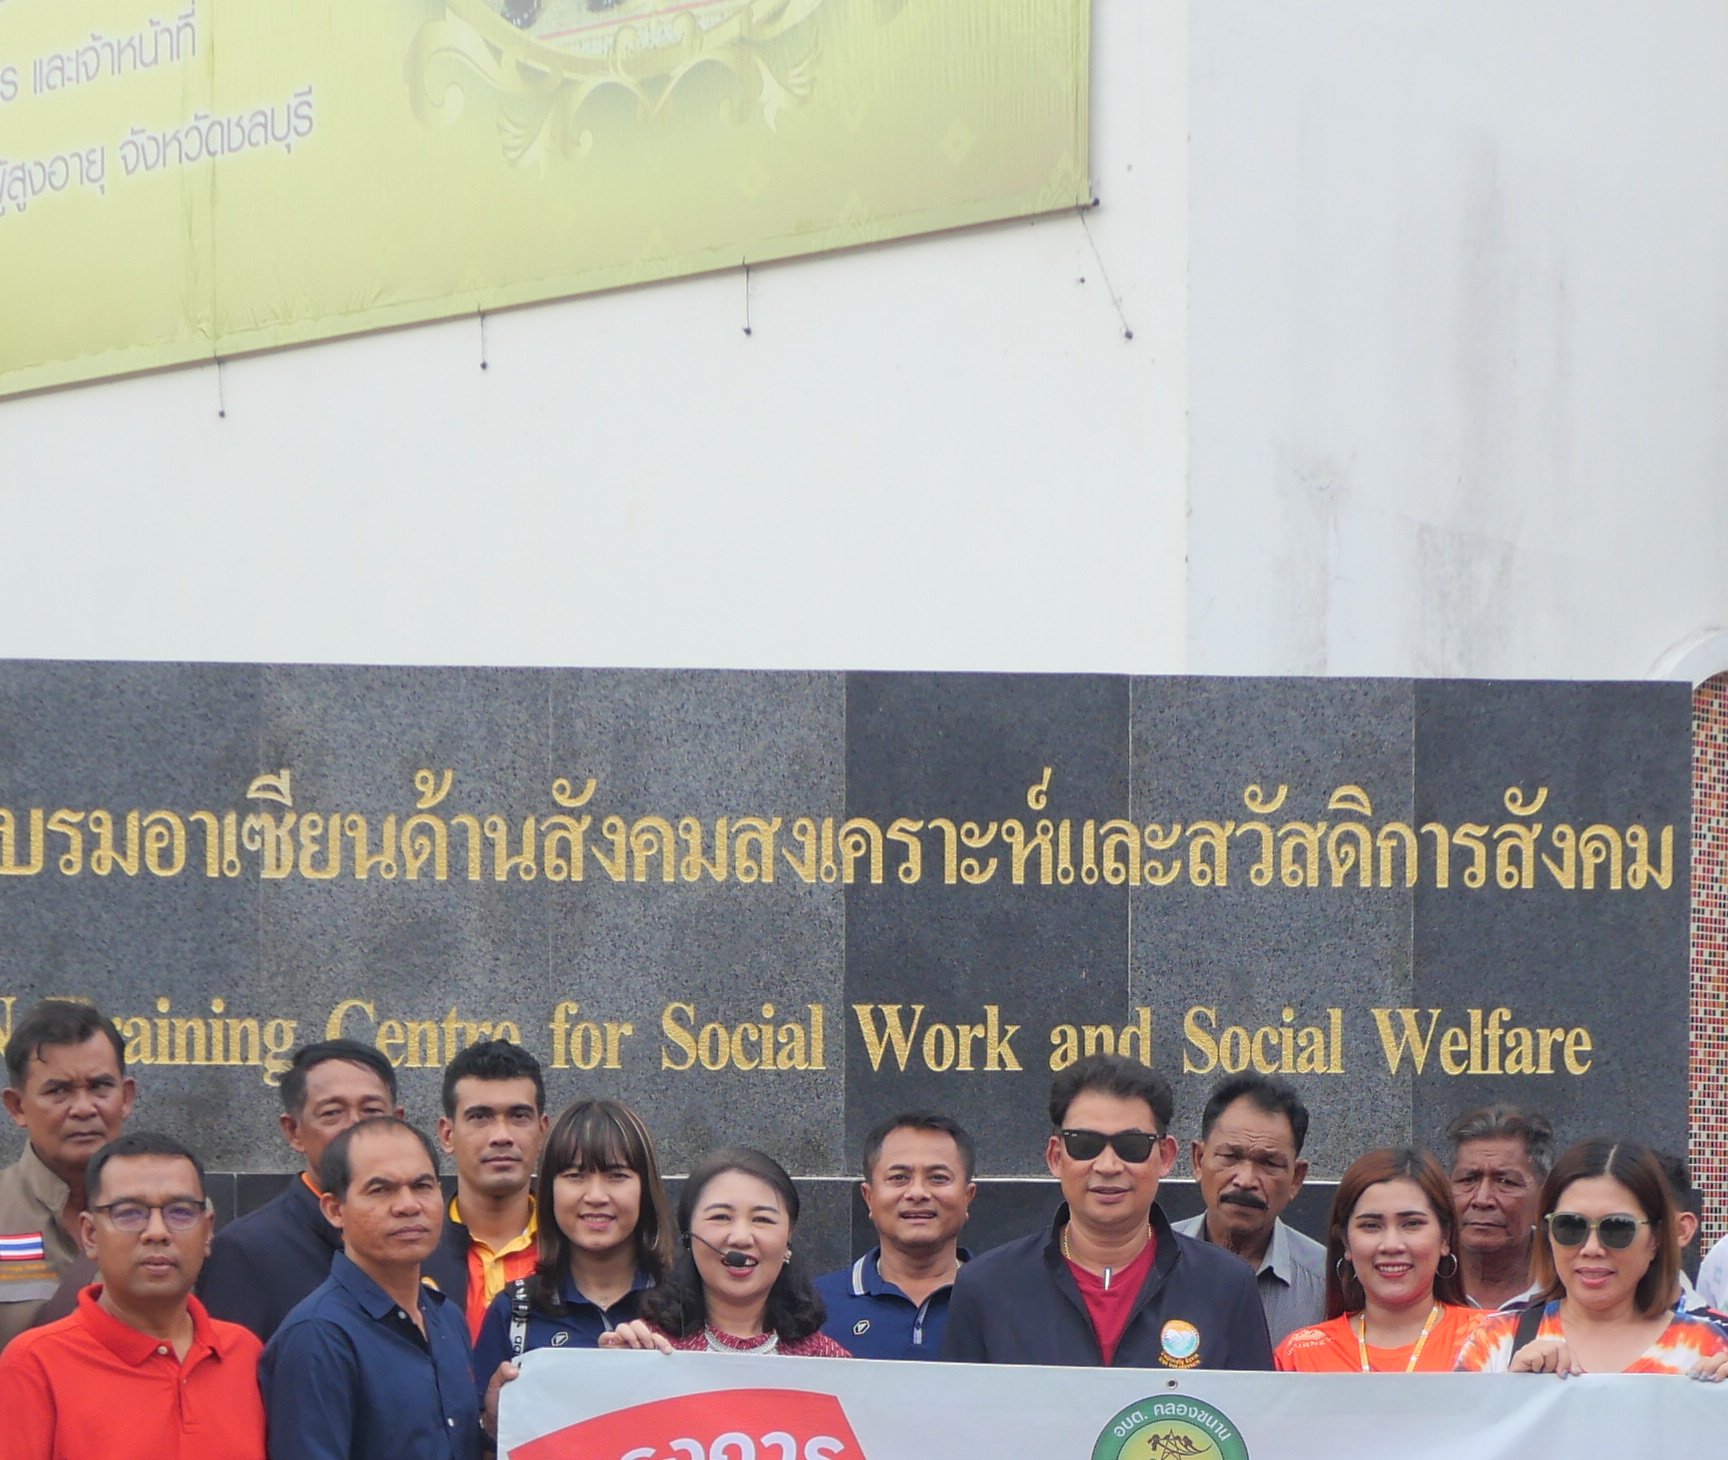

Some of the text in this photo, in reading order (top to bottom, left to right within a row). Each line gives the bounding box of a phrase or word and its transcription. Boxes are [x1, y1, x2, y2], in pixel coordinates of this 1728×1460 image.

[34, 2, 197, 95] และเจ้าหน้าที่
[119, 87, 315, 178] จังหวัดชลบุรี
[548, 1001, 633, 1069] for
[661, 1002, 826, 1071] Social
[852, 1004, 1023, 1072] Work
[1049, 1006, 1155, 1069] and
[1183, 1005, 1345, 1074] Social
[1370, 1007, 1594, 1076] Welfare
[1113, 1402, 1232, 1441] อบต. คลองขนาน
